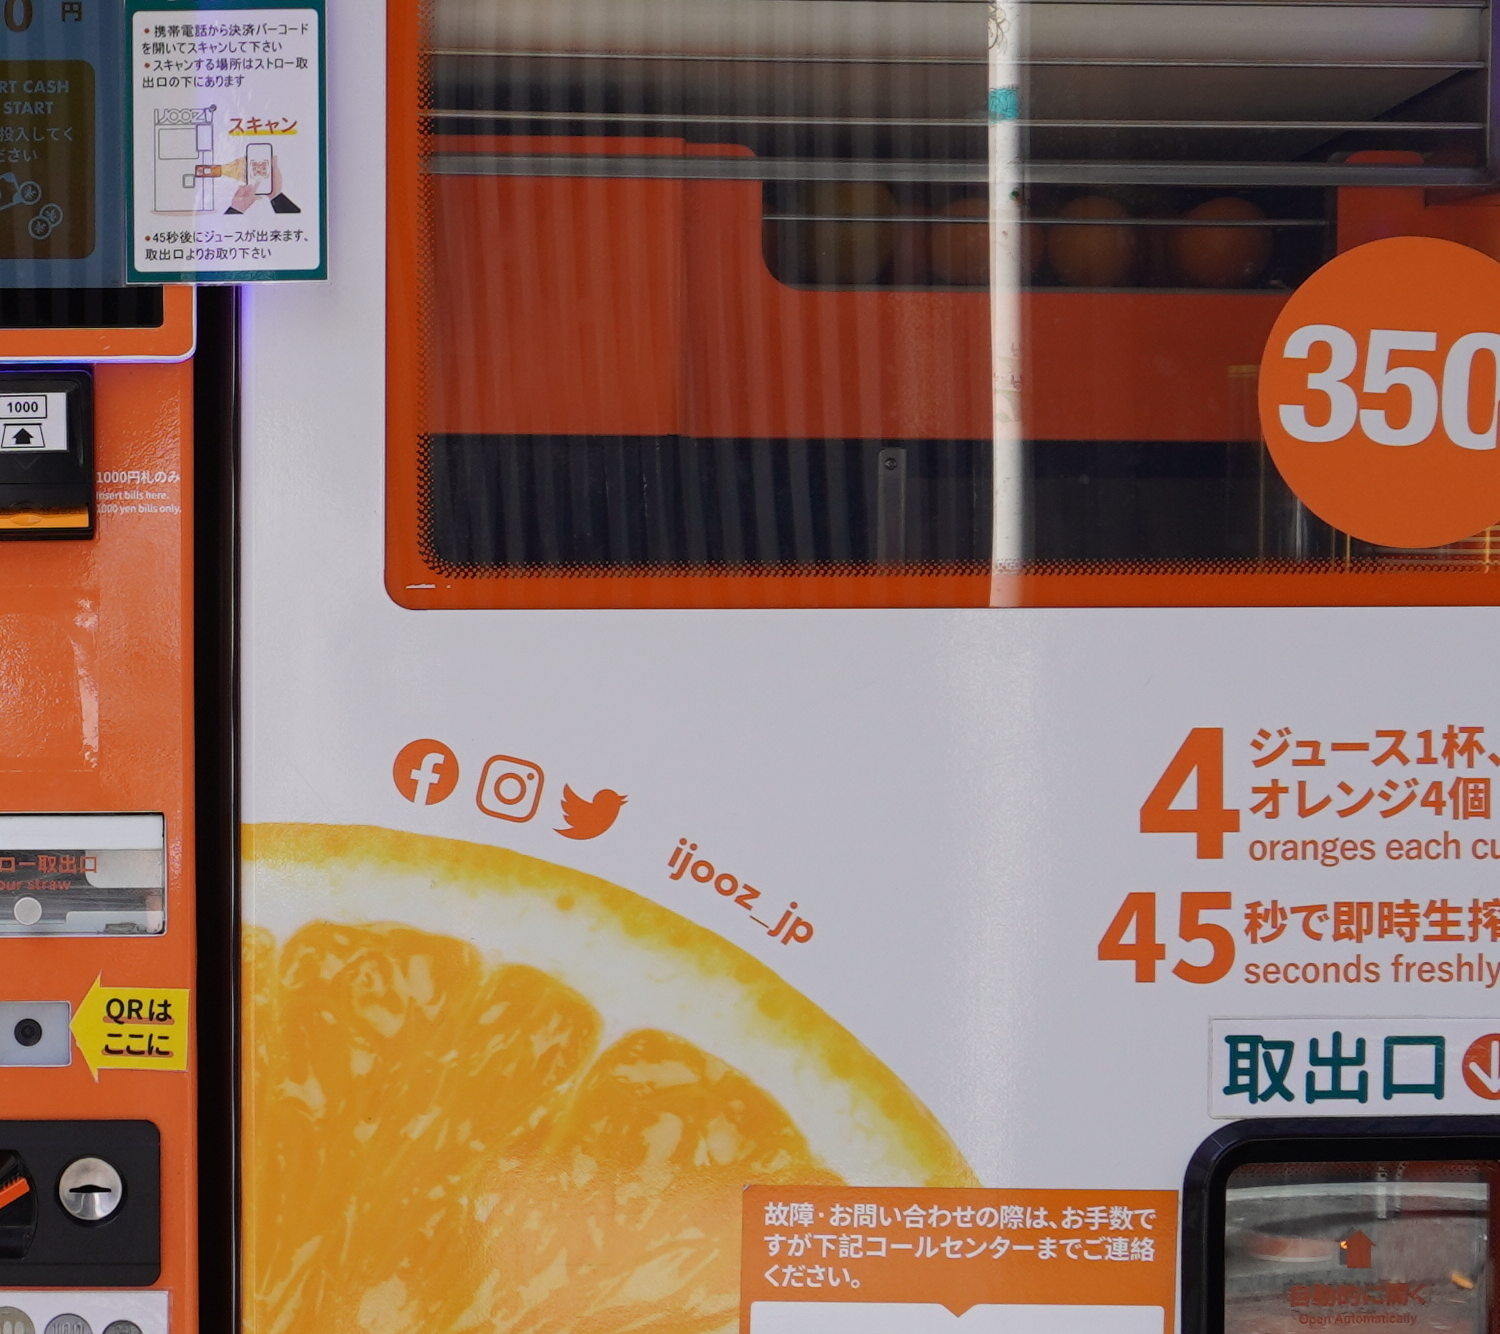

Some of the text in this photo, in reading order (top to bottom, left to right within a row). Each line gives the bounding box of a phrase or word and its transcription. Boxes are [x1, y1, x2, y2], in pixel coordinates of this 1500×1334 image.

[62, 1, 82, 22] 円
[23, 80, 69, 93] CASH
[3, 101, 53, 114] START
[229, 117, 297, 134] スキャン
[6, 399, 39, 414] 1000
[96, 471, 180, 484] 1000円札のみ
[124, 491, 143, 499] bills
[1140, 728, 1240, 859] 4
[1250, 778, 1491, 820] オレンジ4個
[1249, 836, 1375, 867] oranges
[1385, 833, 1461, 860] each
[27, 879, 70, 890] straw
[667, 838, 813, 945] ijooz_jp
[1098, 892, 1235, 983] 45
[1245, 955, 1380, 984] seconds
[1392, 954, 1500, 987] freshly
[106, 998, 172, 1025] QRは
[104, 1033, 170, 1055] ここに
[1223, 1031, 1445, 1103] 取出口
[763, 1234, 1156, 1261] すが下記コールセンターまでご連絡
[764, 1266, 860, 1289] ください。
[1299, 1313, 1418, 1326] Open Automatically
